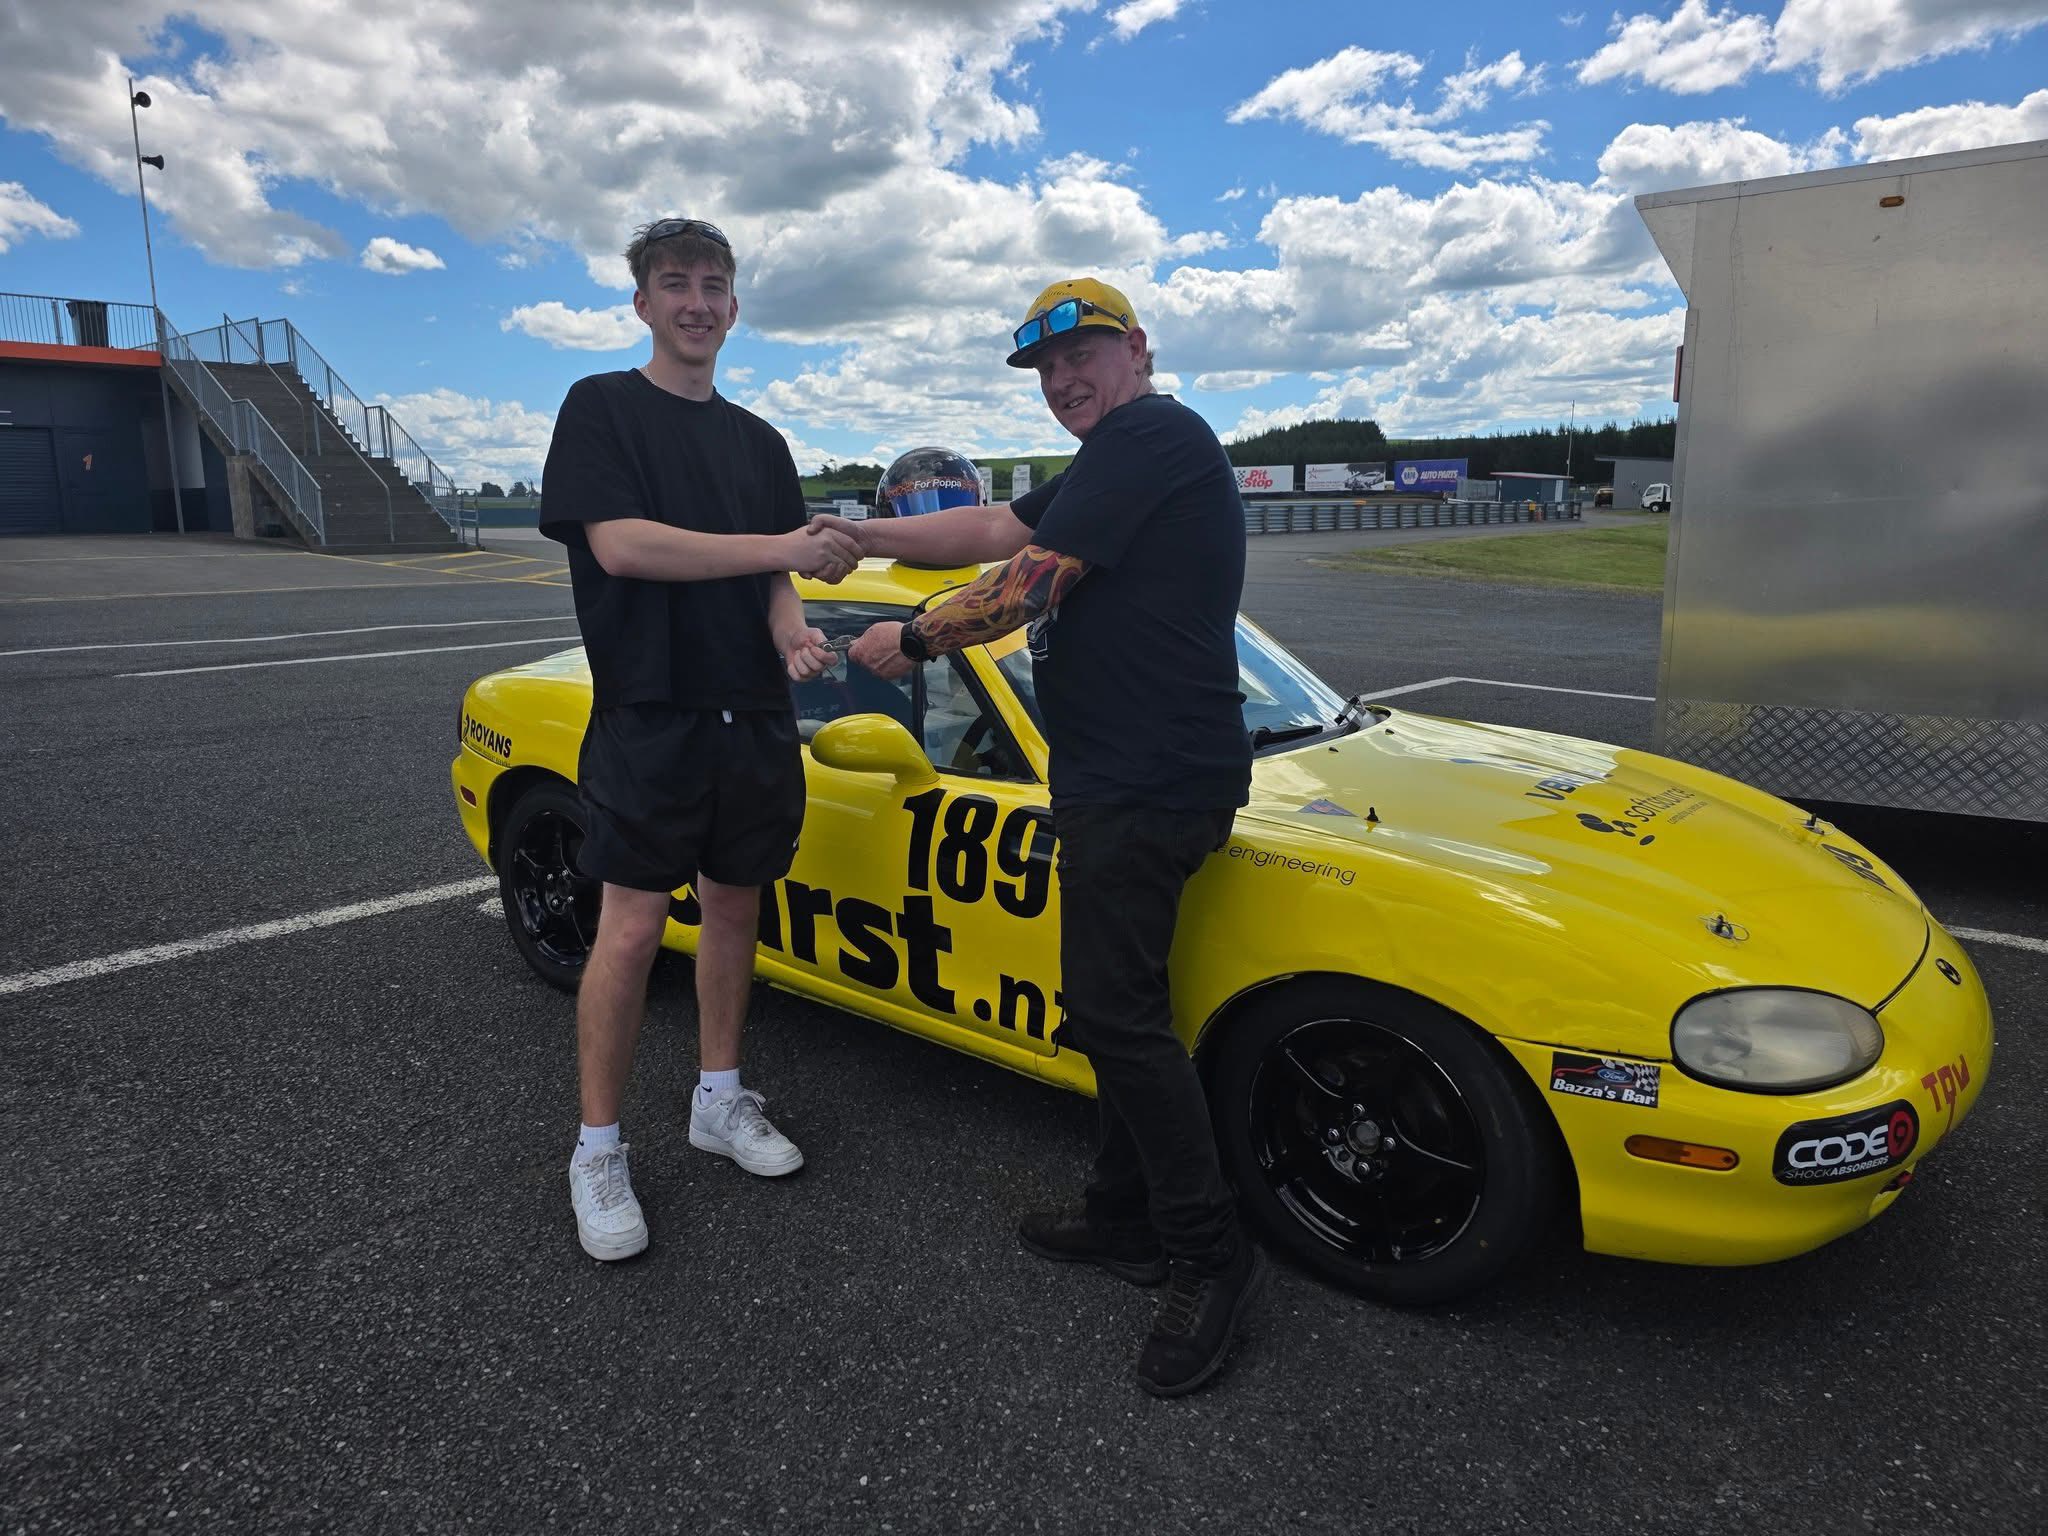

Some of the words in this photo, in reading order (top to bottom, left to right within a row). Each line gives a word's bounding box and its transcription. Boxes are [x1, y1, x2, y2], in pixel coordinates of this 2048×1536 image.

[83, 454, 93, 471] 1
[1251, 469, 1267, 479] Pit
[1420, 470, 1437, 479] AUTO
[1438, 469, 1459, 479] PARTS
[914, 480, 930, 490] For
[933, 478, 961, 489] Poppa
[1244, 478, 1273, 488] Stop
[470, 718, 512, 759] ROYANS
[902, 787, 1059, 919] 189
[1229, 846, 1357, 886] engineering
[1604, 1070, 1626, 1081] Ford
[1553, 1078, 1617, 1100] Bazza's
[1622, 1088, 1656, 1105] Bar
